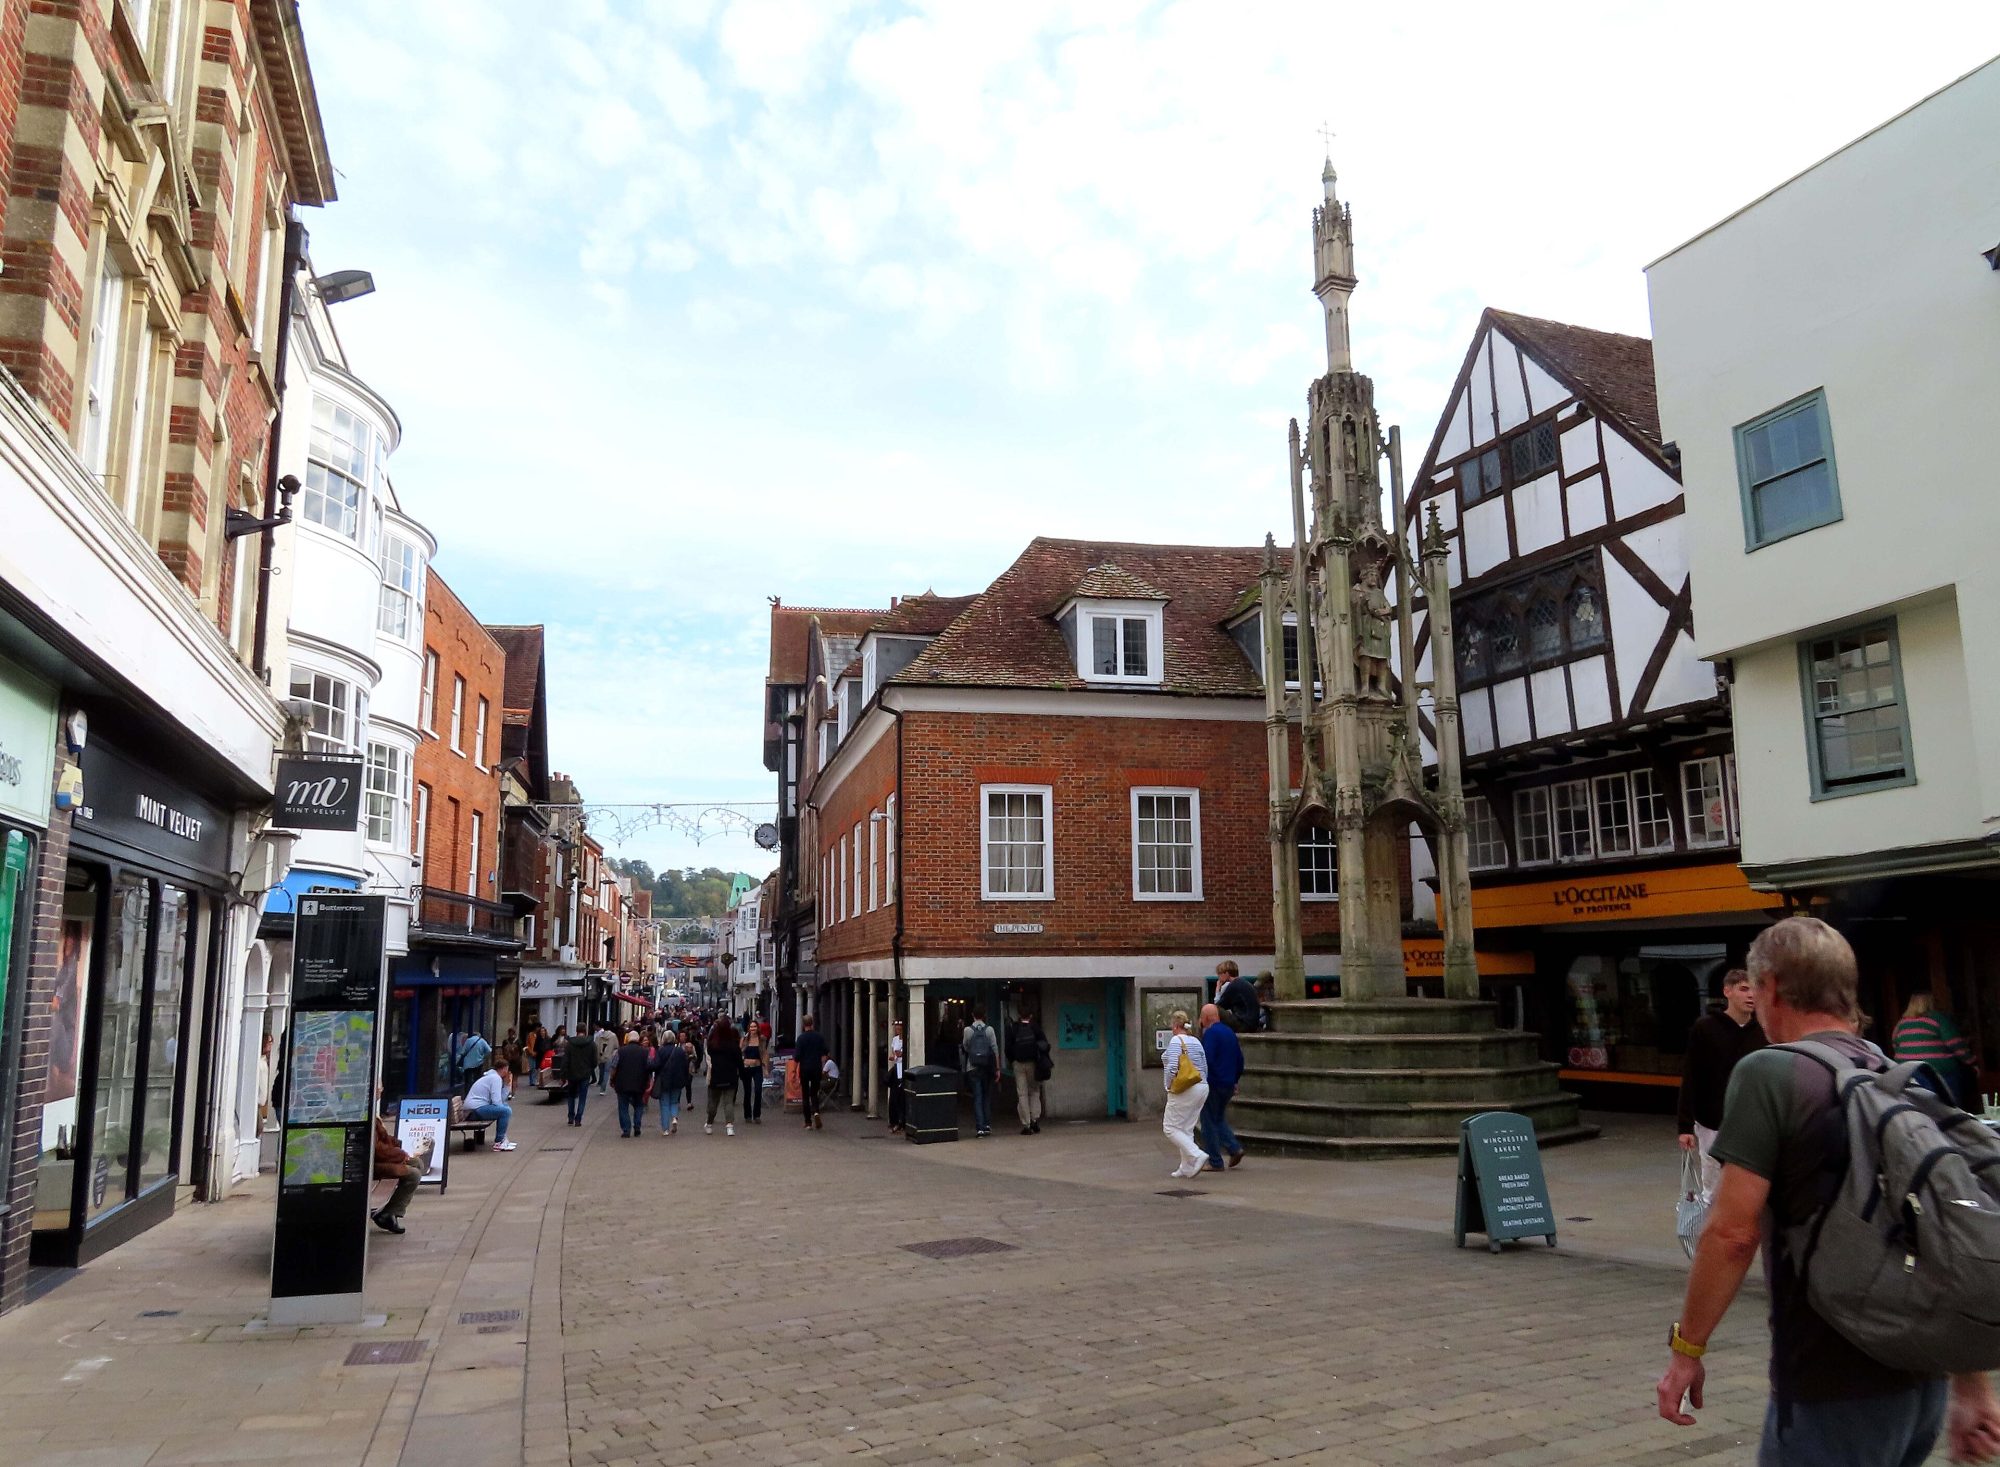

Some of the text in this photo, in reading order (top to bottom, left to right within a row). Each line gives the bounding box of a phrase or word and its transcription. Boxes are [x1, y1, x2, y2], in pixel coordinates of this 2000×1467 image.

[312, 808, 347, 816] VELVET
[137, 794, 202, 842] MINT VELVET
[1553, 883, 1648, 906] L'OCCITANE
[1586, 903, 1632, 914] PROVENCE
[1483, 1135, 1528, 1143] WINCHESTER
[1494, 1145, 1521, 1153] BAKERY
[1514, 1173, 1530, 1181] BAKED
[1502, 1196, 1525, 1204] PASTRIES
[1523, 1202, 1543, 1210] COFFEE
[1502, 1219, 1523, 1227] SEATING
